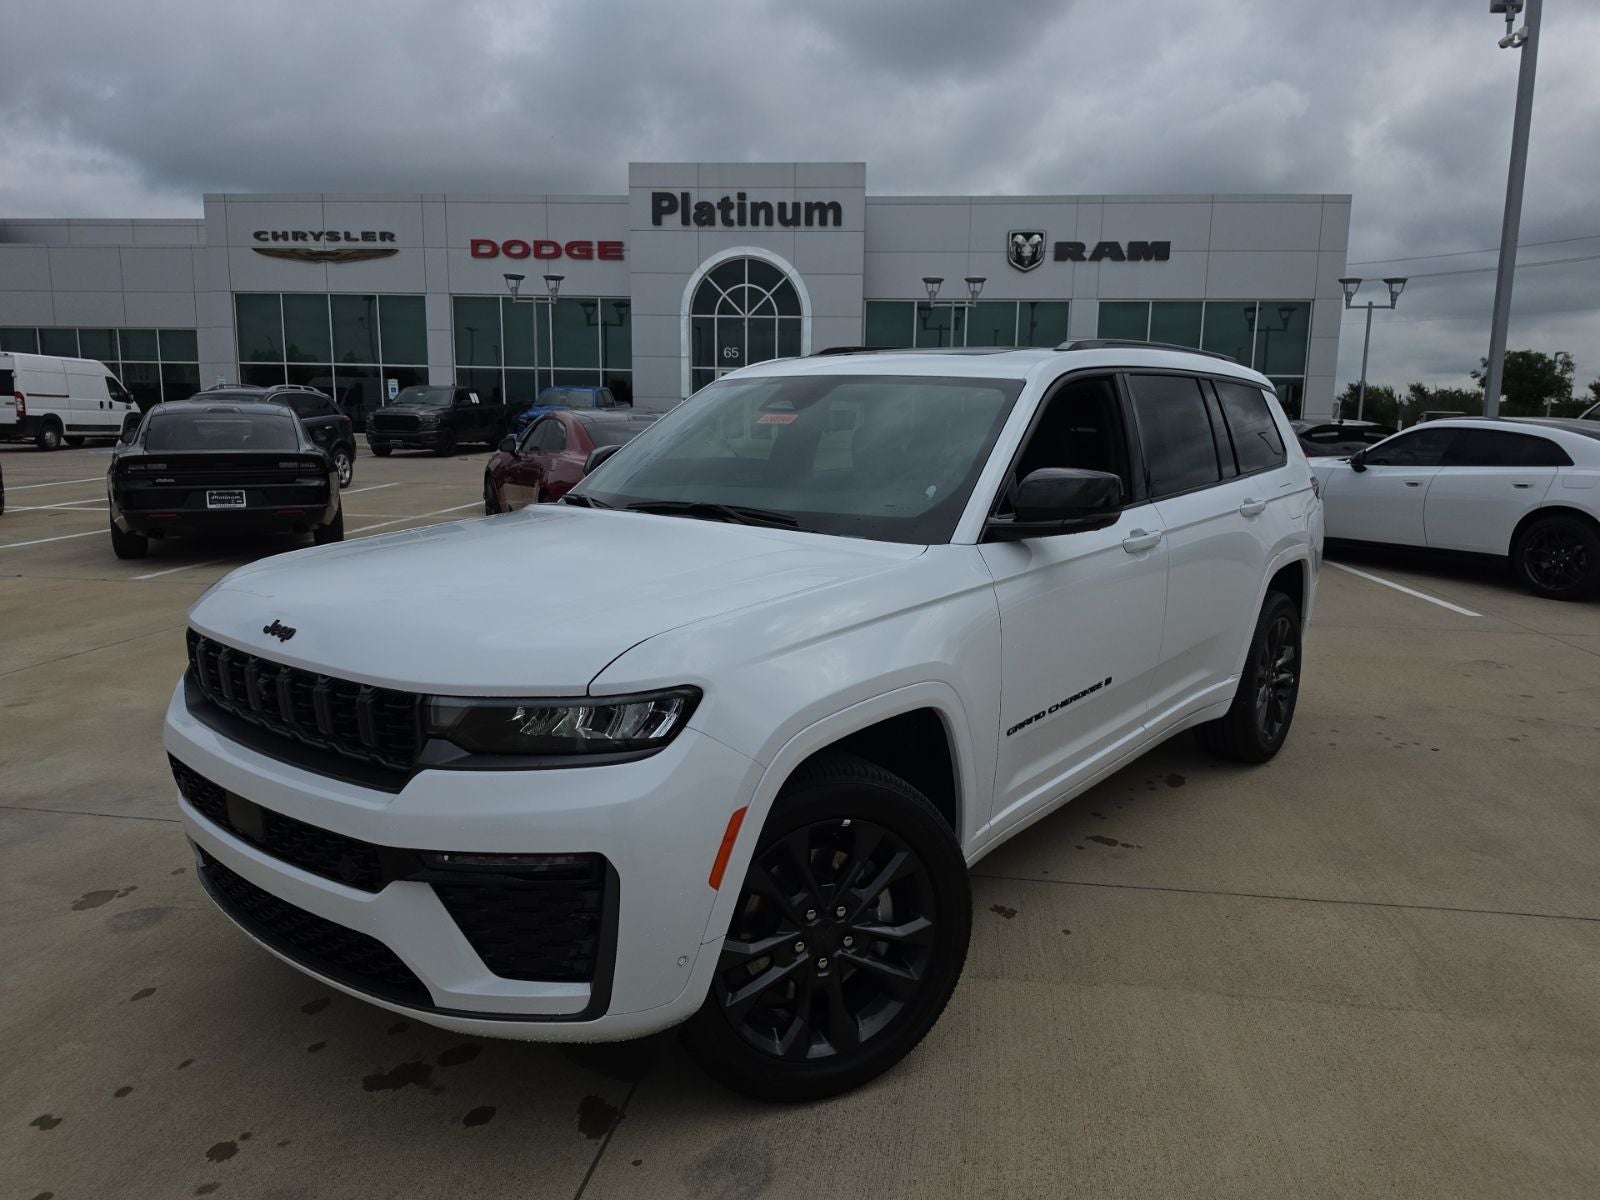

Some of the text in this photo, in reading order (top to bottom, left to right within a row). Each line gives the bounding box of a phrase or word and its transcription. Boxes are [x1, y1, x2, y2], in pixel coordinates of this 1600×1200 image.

[651, 191, 842, 227] Platinum
[253, 230, 396, 242] CHRYSLER
[470, 238, 625, 260] DODGE
[1054, 241, 1171, 262] RAM
[723, 346, 739, 359] 65
[262, 619, 297, 643] Jeep
[1006, 681, 1104, 737] GRAND CHEROKEE
